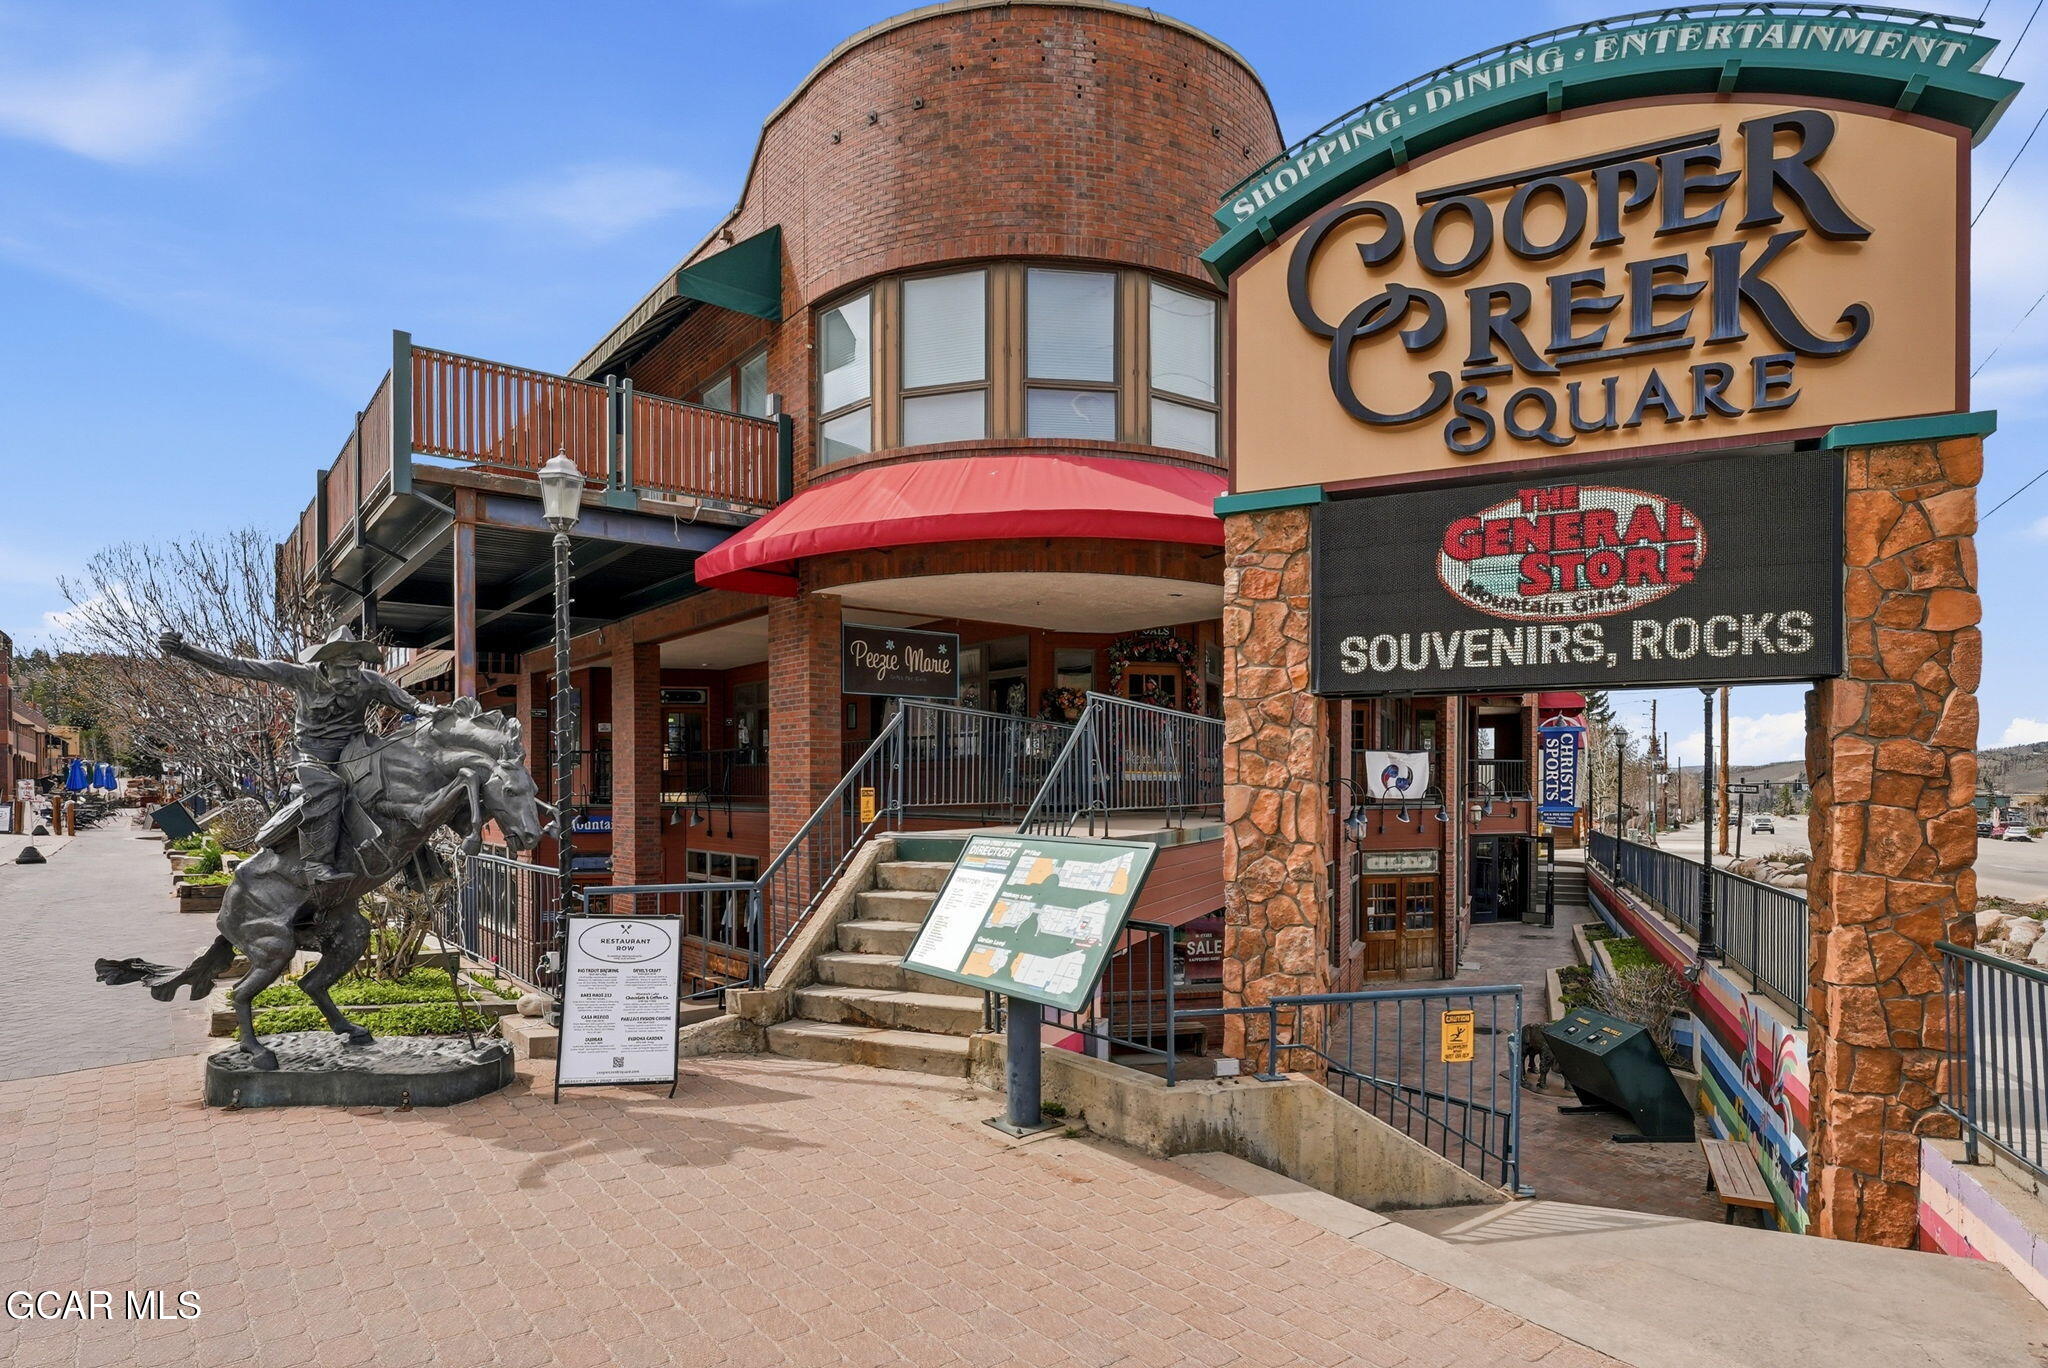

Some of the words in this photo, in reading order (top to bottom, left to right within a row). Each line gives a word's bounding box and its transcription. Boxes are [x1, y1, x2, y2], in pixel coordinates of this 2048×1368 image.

[1233, 106, 1402, 222] SHOPPING
[1425, 46, 1564, 114] DINING
[1594, 20, 1970, 68] ENTERTAINMENT
[1287, 110, 1872, 338] COOPER
[1329, 230, 1874, 426] CREEK
[1444, 352, 1802, 456] SQUARE
[1517, 485, 1580, 512] THE
[1443, 504, 1698, 561] GENERAL
[1518, 543, 1697, 597] STORE
[850, 640, 900, 681] Peezie
[904, 645, 952, 675] Marie
[1340, 622, 1616, 674] SOUVENIRS,
[1631, 610, 1814, 660] ROCKS
[1545, 738, 1559, 801] SPORTS
[1560, 732, 1575, 805] CHRISTY
[968, 845, 1018, 858] DIRECTORY
[1187, 940, 1222, 955] SALE
